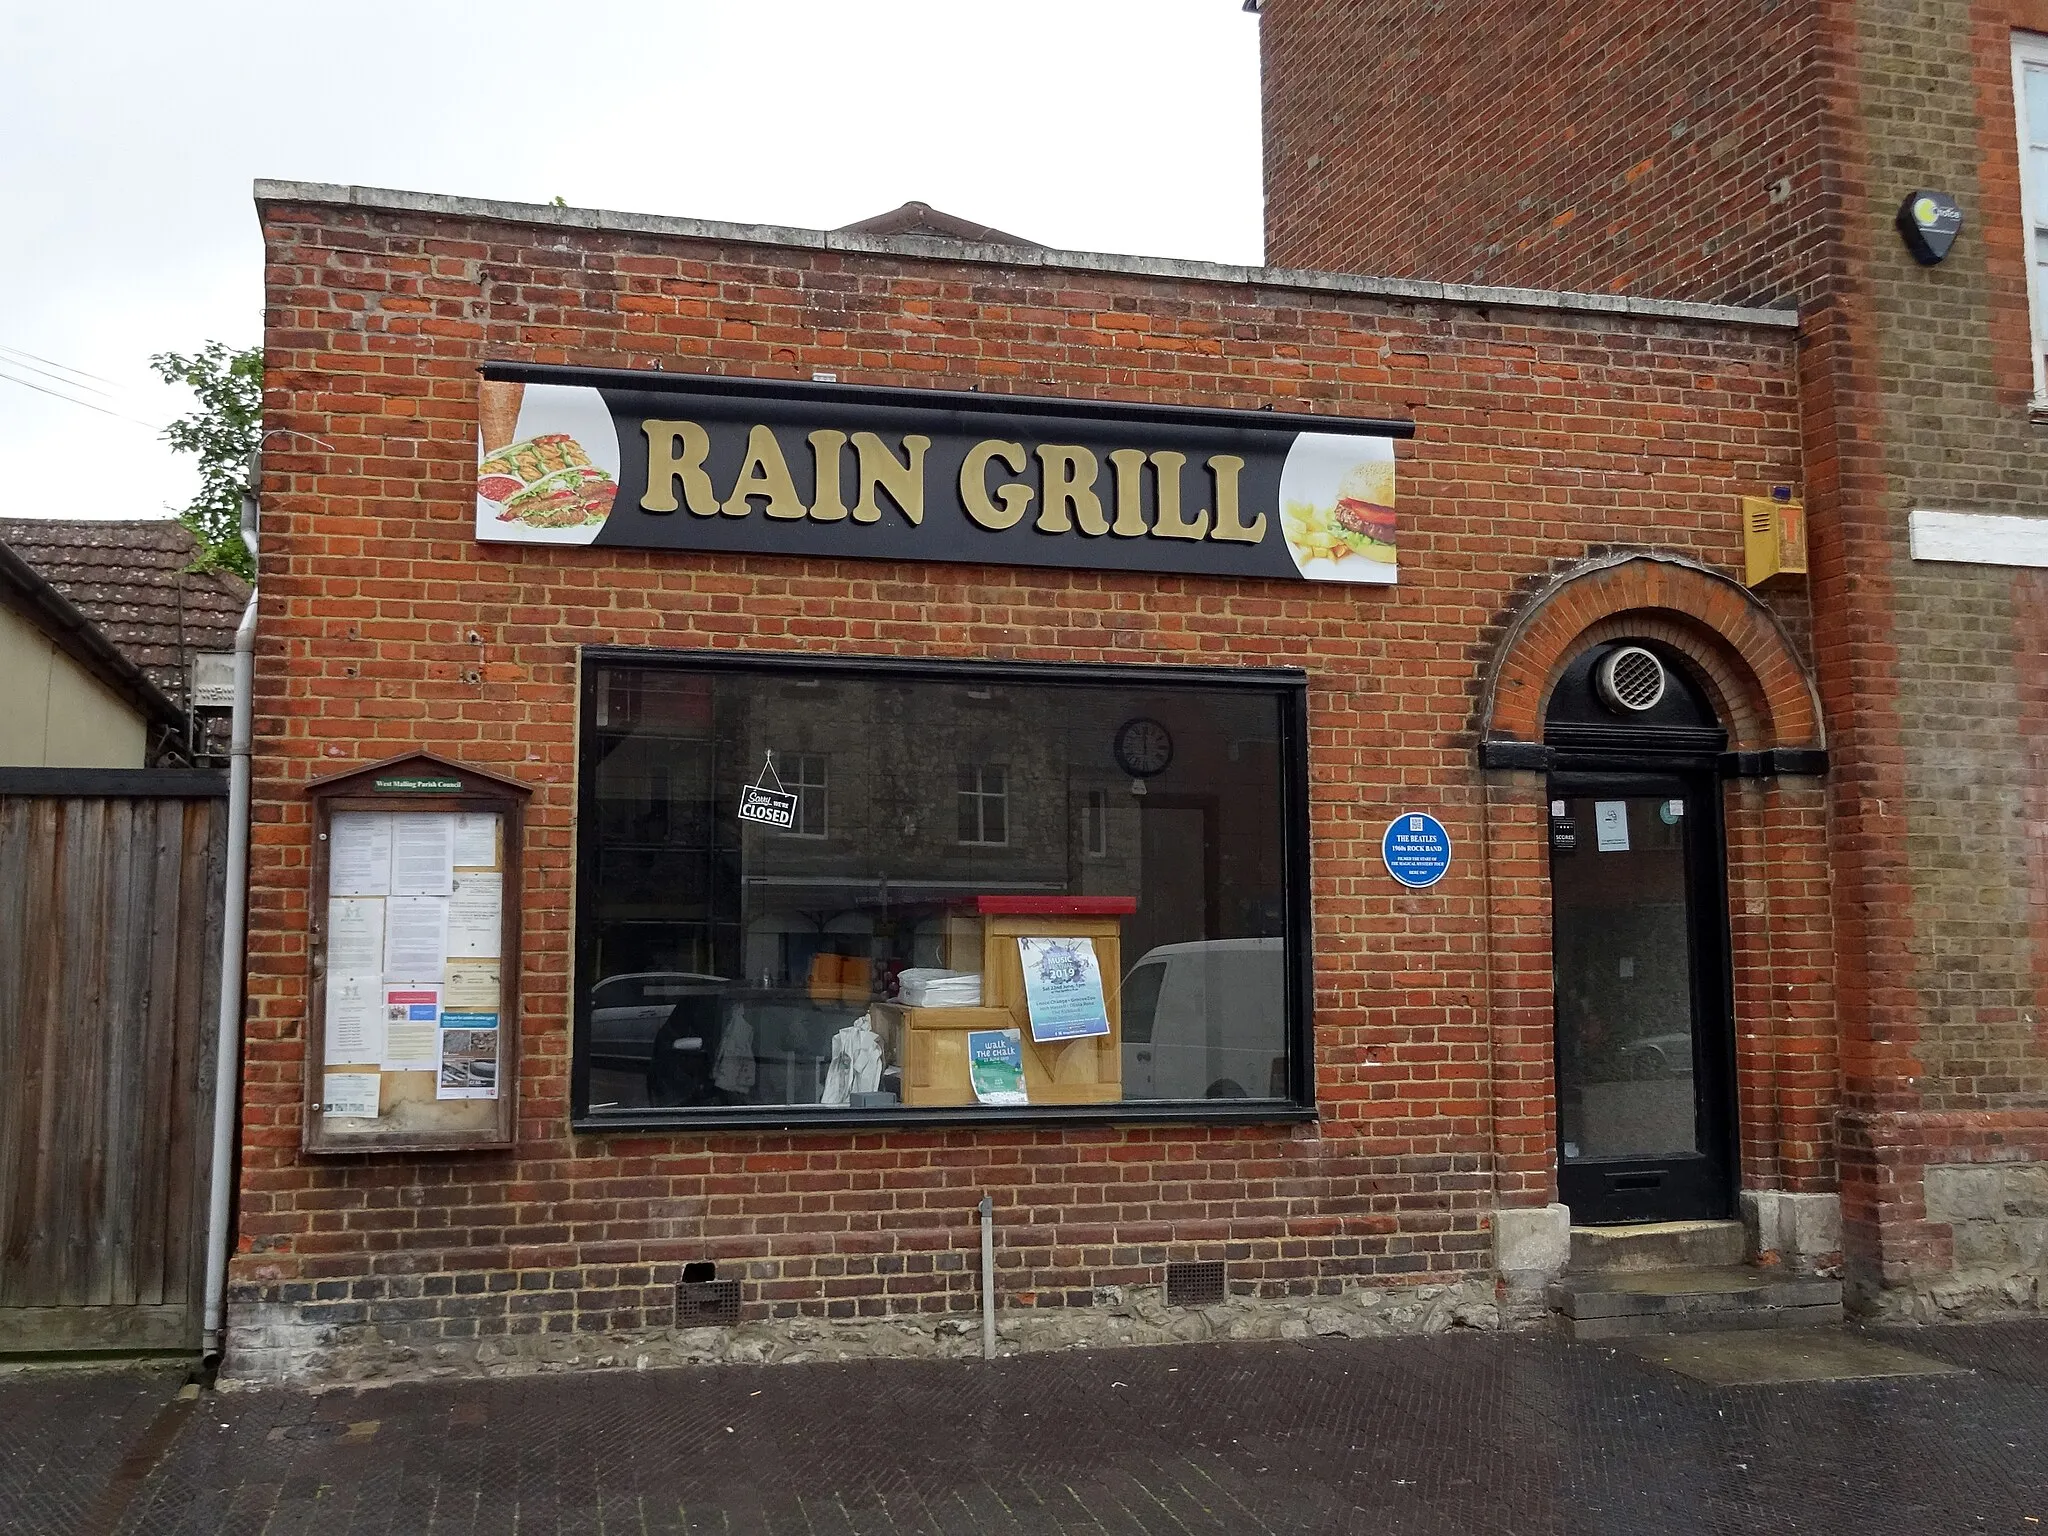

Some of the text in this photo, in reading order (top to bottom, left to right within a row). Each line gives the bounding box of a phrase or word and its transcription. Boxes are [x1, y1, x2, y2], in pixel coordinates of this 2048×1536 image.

[640, 419, 1267, 544] RAIN GRILL
[748, 792, 772, 806] Sorry
[742, 804, 789, 823] CLOSED
[1396, 835, 1437, 843] THE BEATLES
[1047, 955, 1073, 965] MUSIC
[1049, 968, 1075, 979] 2019
